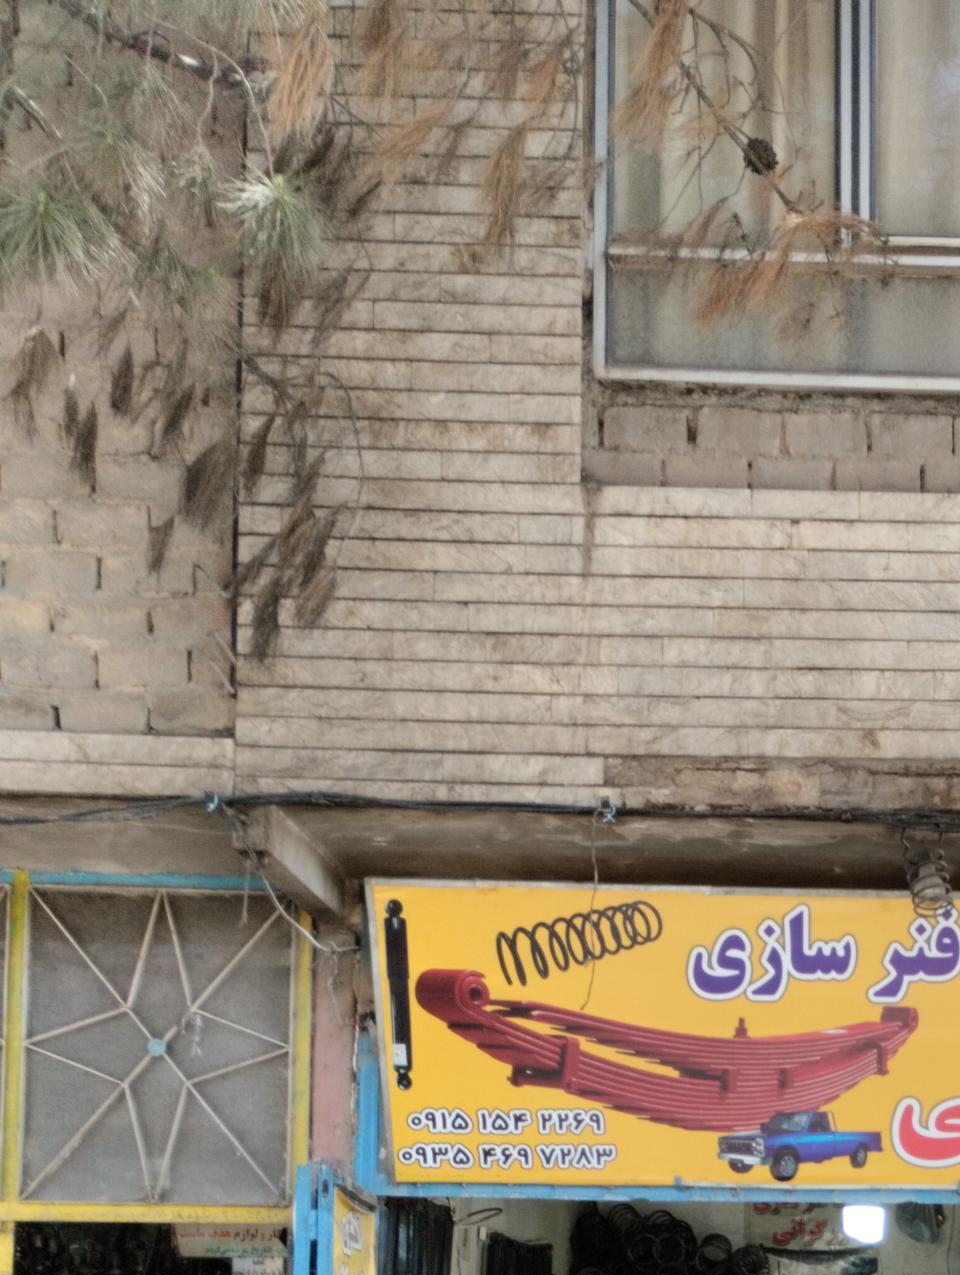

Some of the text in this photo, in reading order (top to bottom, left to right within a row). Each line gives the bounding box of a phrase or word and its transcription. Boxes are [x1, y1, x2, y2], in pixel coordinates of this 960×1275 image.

[688, 904, 856, 1001] سازی
[408, 1108, 605, 1134] ۰۹۱۵ ۱۵۴ ۲۲۶۹
[399, 1143, 616, 1169] ۰۹۳۵ ۴۶۹ ۷۲۸۳
